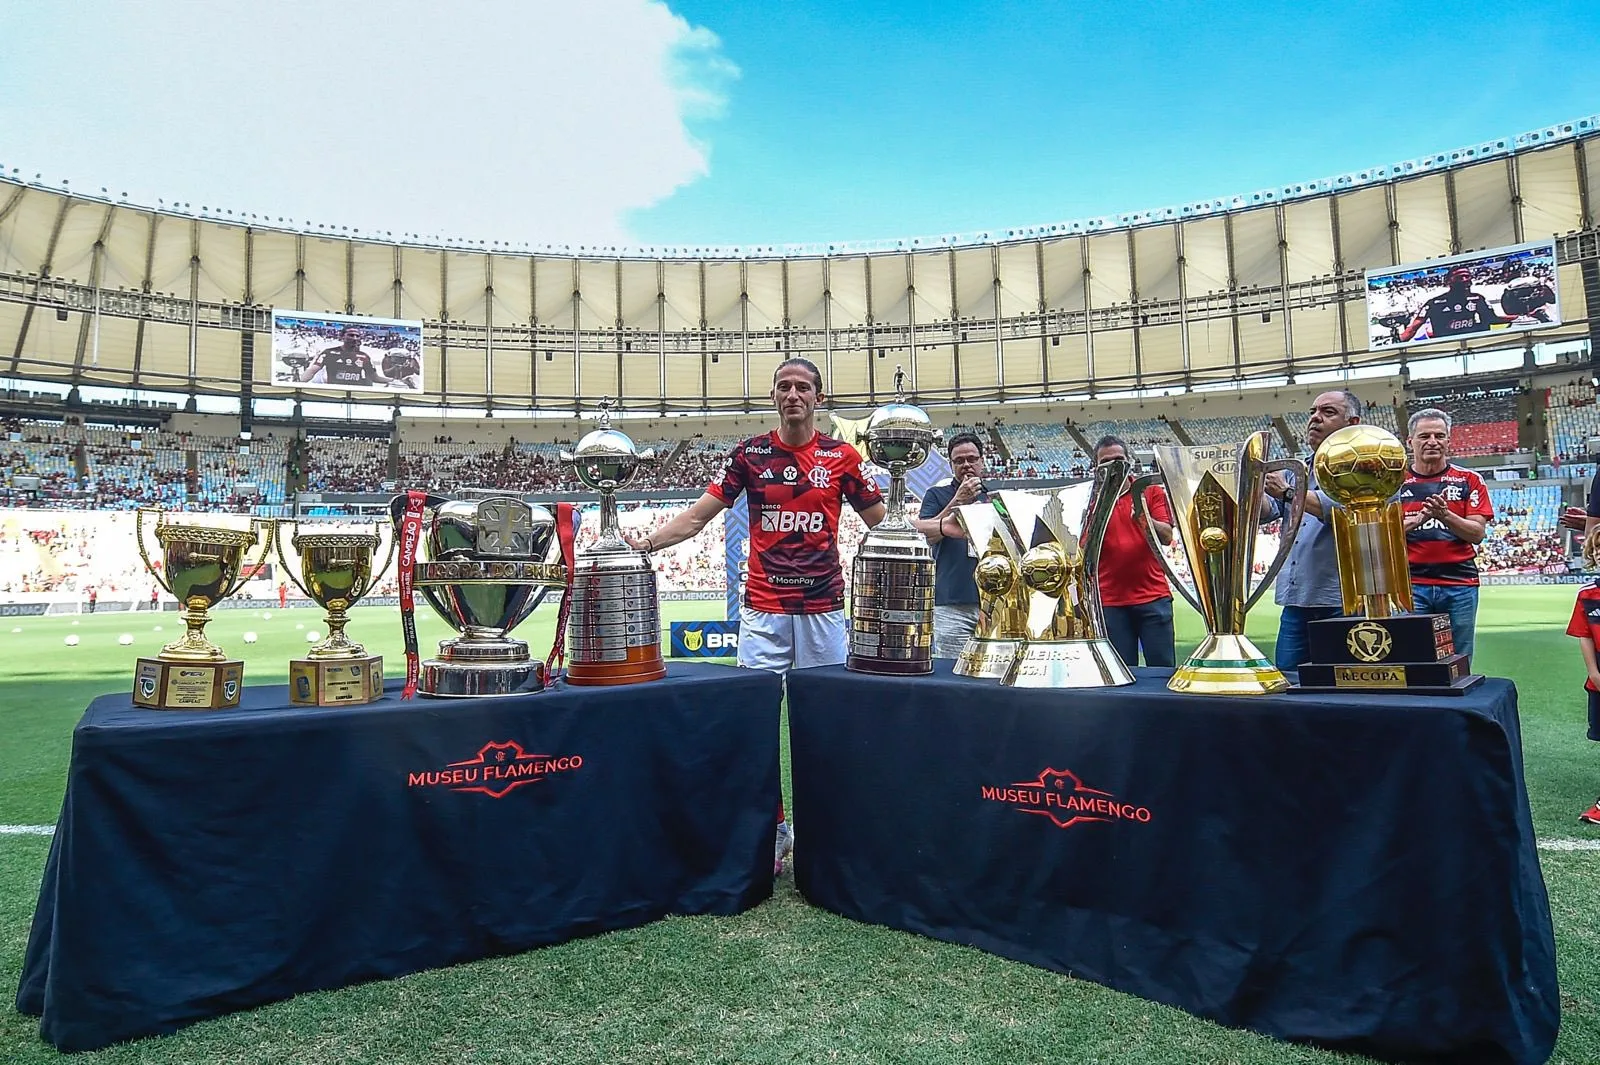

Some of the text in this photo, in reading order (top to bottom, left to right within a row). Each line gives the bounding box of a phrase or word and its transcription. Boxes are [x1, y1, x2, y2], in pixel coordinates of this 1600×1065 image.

[745, 445, 772, 454] pixbet
[814, 450, 842, 458] pixbet
[779, 511, 824, 533] BRB
[402, 521, 417, 567] CAMPEÃO
[492, 564, 516, 578] DO
[776, 577, 815, 586] MoonPay
[1342, 671, 1399, 681] RECOPA
[407, 755, 583, 786] MUSEU FLAMENGO
[981, 785, 1151, 823] MUSEU FLAMENGO
